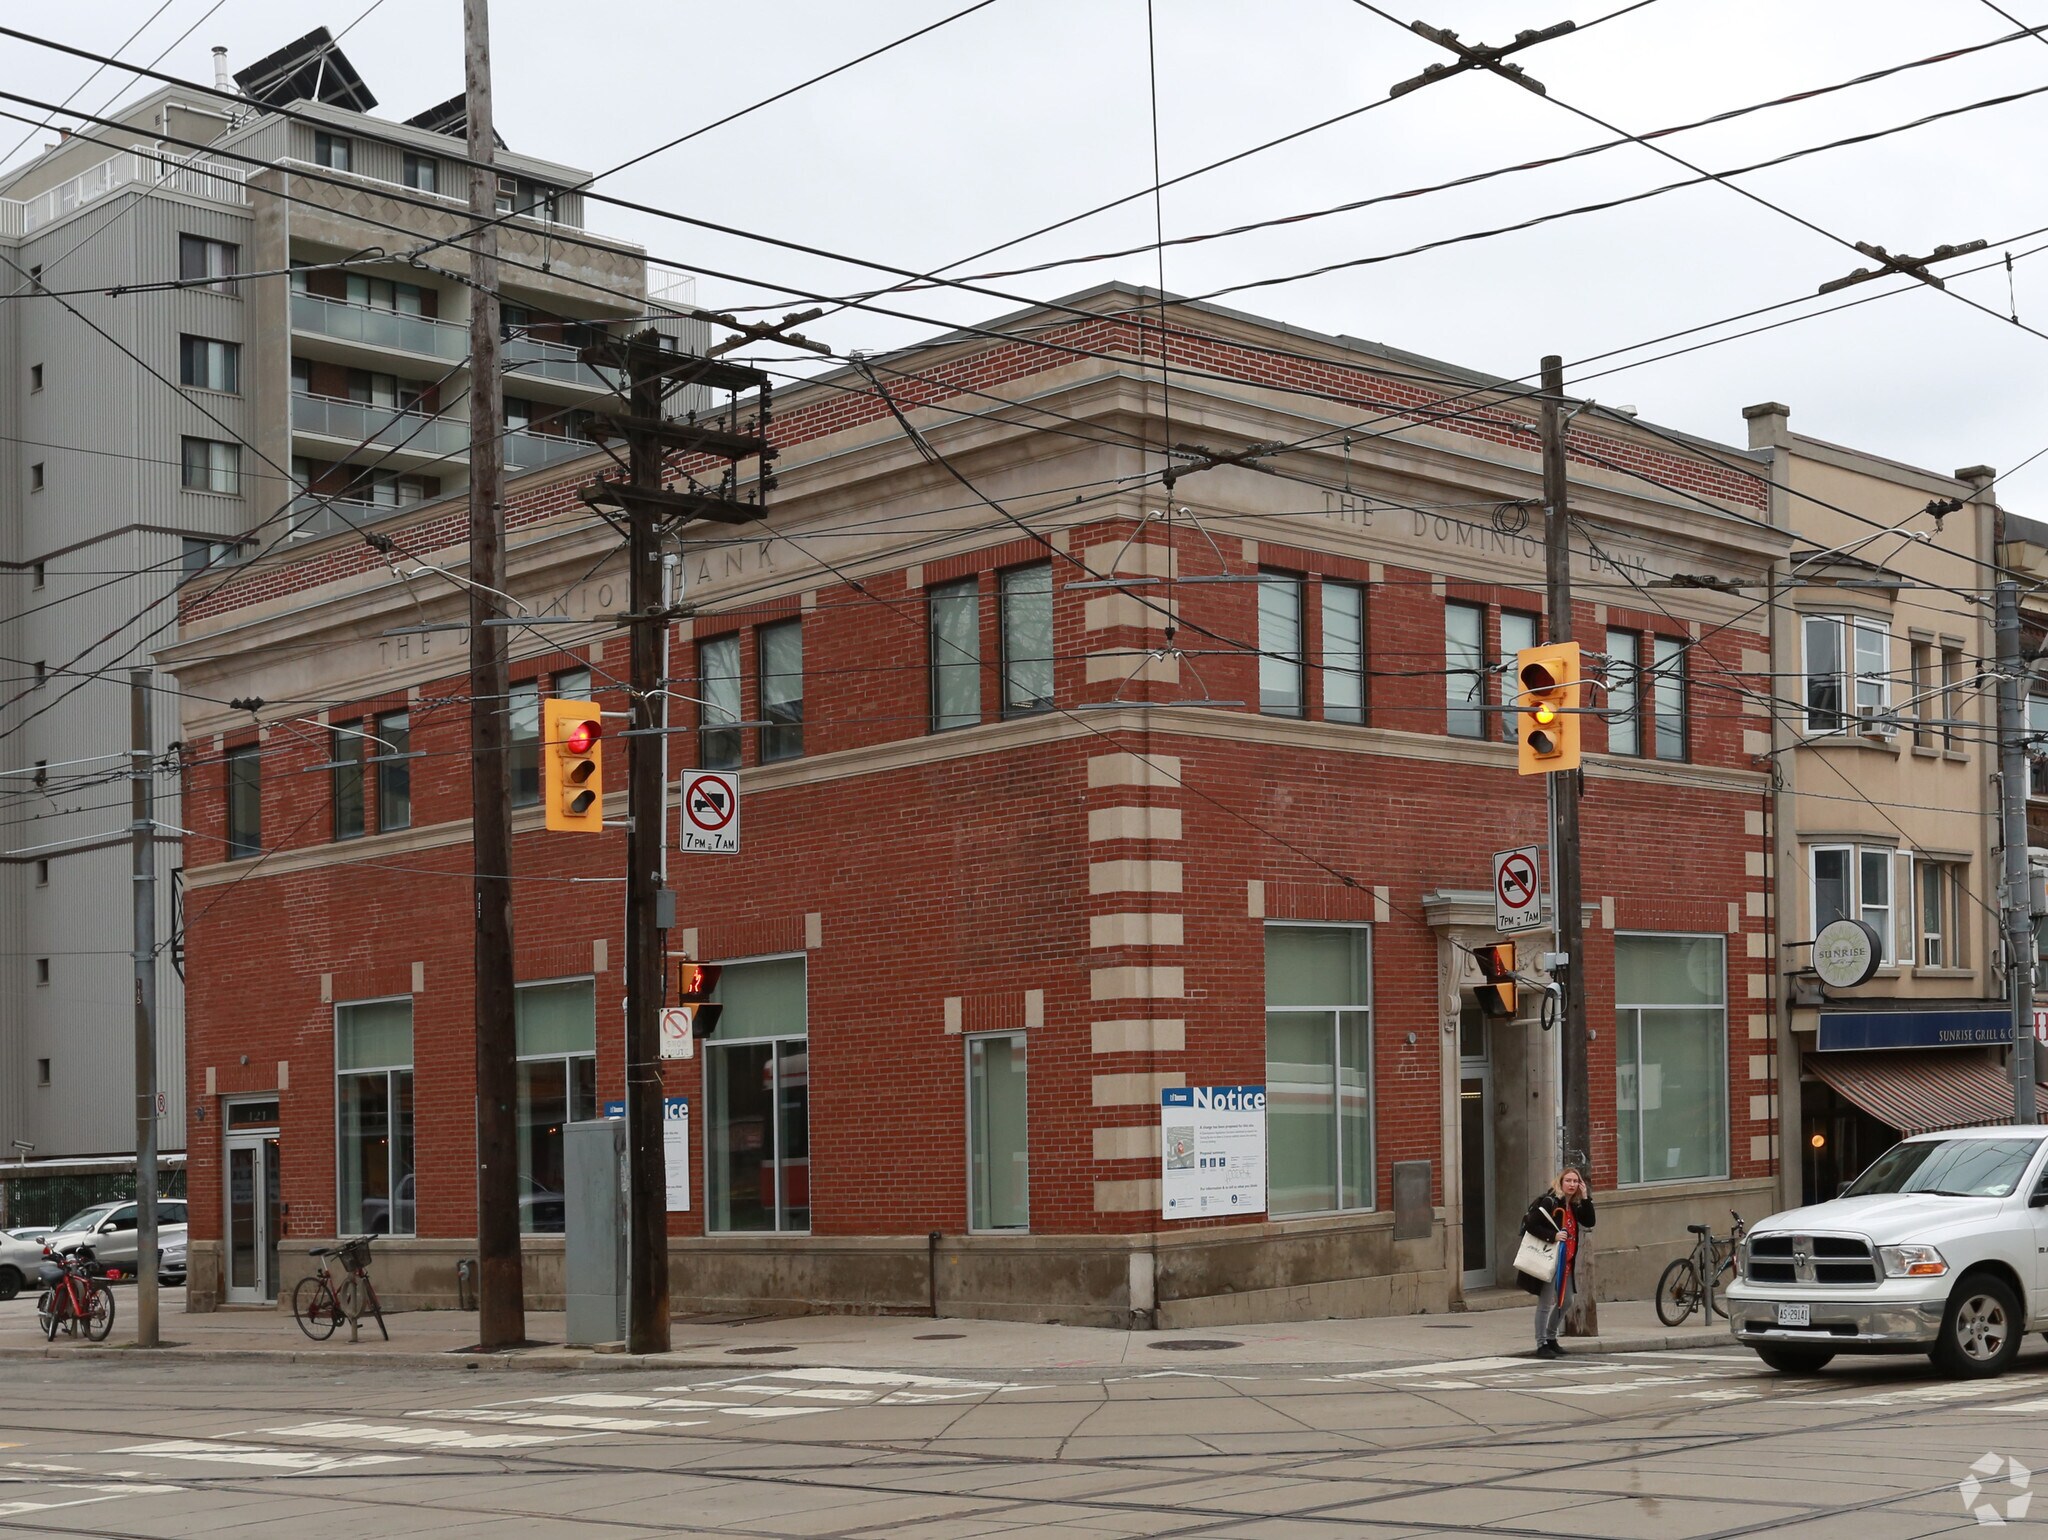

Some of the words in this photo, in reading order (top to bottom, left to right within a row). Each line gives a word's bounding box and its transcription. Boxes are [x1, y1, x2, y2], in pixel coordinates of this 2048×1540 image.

[1322, 490, 1374, 527] THE
[1589, 545, 1648, 582] BANK
[378, 631, 431, 665] THE
[1819, 947, 1867, 959] SUNRISE
[1939, 1029, 1972, 1042] SUNRISE
[1975, 1028, 1998, 1041] GRILL
[2000, 1028, 2006, 1039] &
[1193, 1086, 1265, 1110] Notice
[249, 1111, 266, 1121] 121
